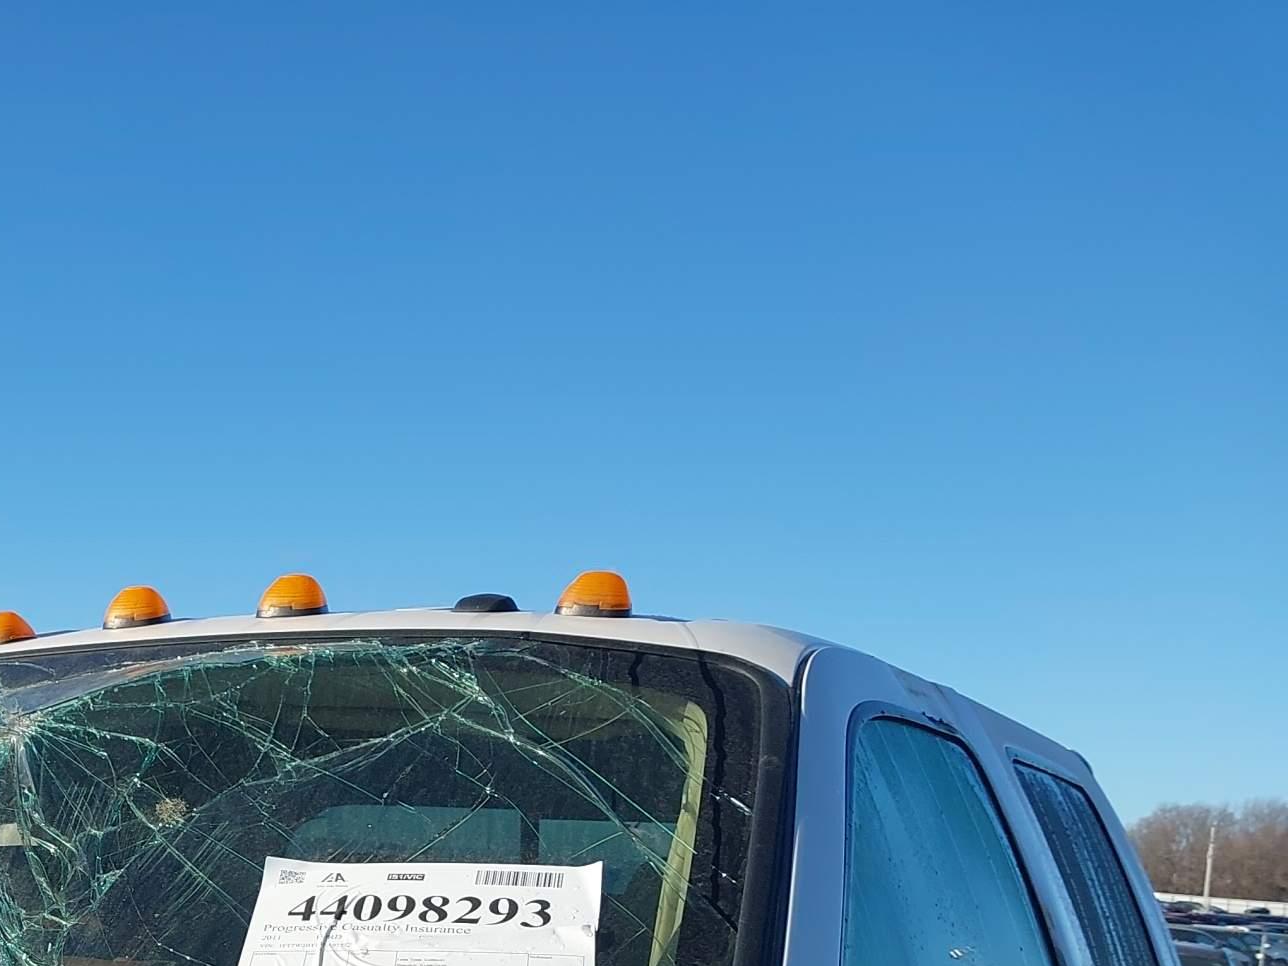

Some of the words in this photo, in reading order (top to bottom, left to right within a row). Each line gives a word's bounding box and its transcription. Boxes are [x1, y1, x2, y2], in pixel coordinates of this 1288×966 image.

[287, 893, 553, 929] 44098293
[263, 922, 338, 934] Progressive
[342, 922, 401, 934] Casualty
[405, 923, 472, 935] Insurance
